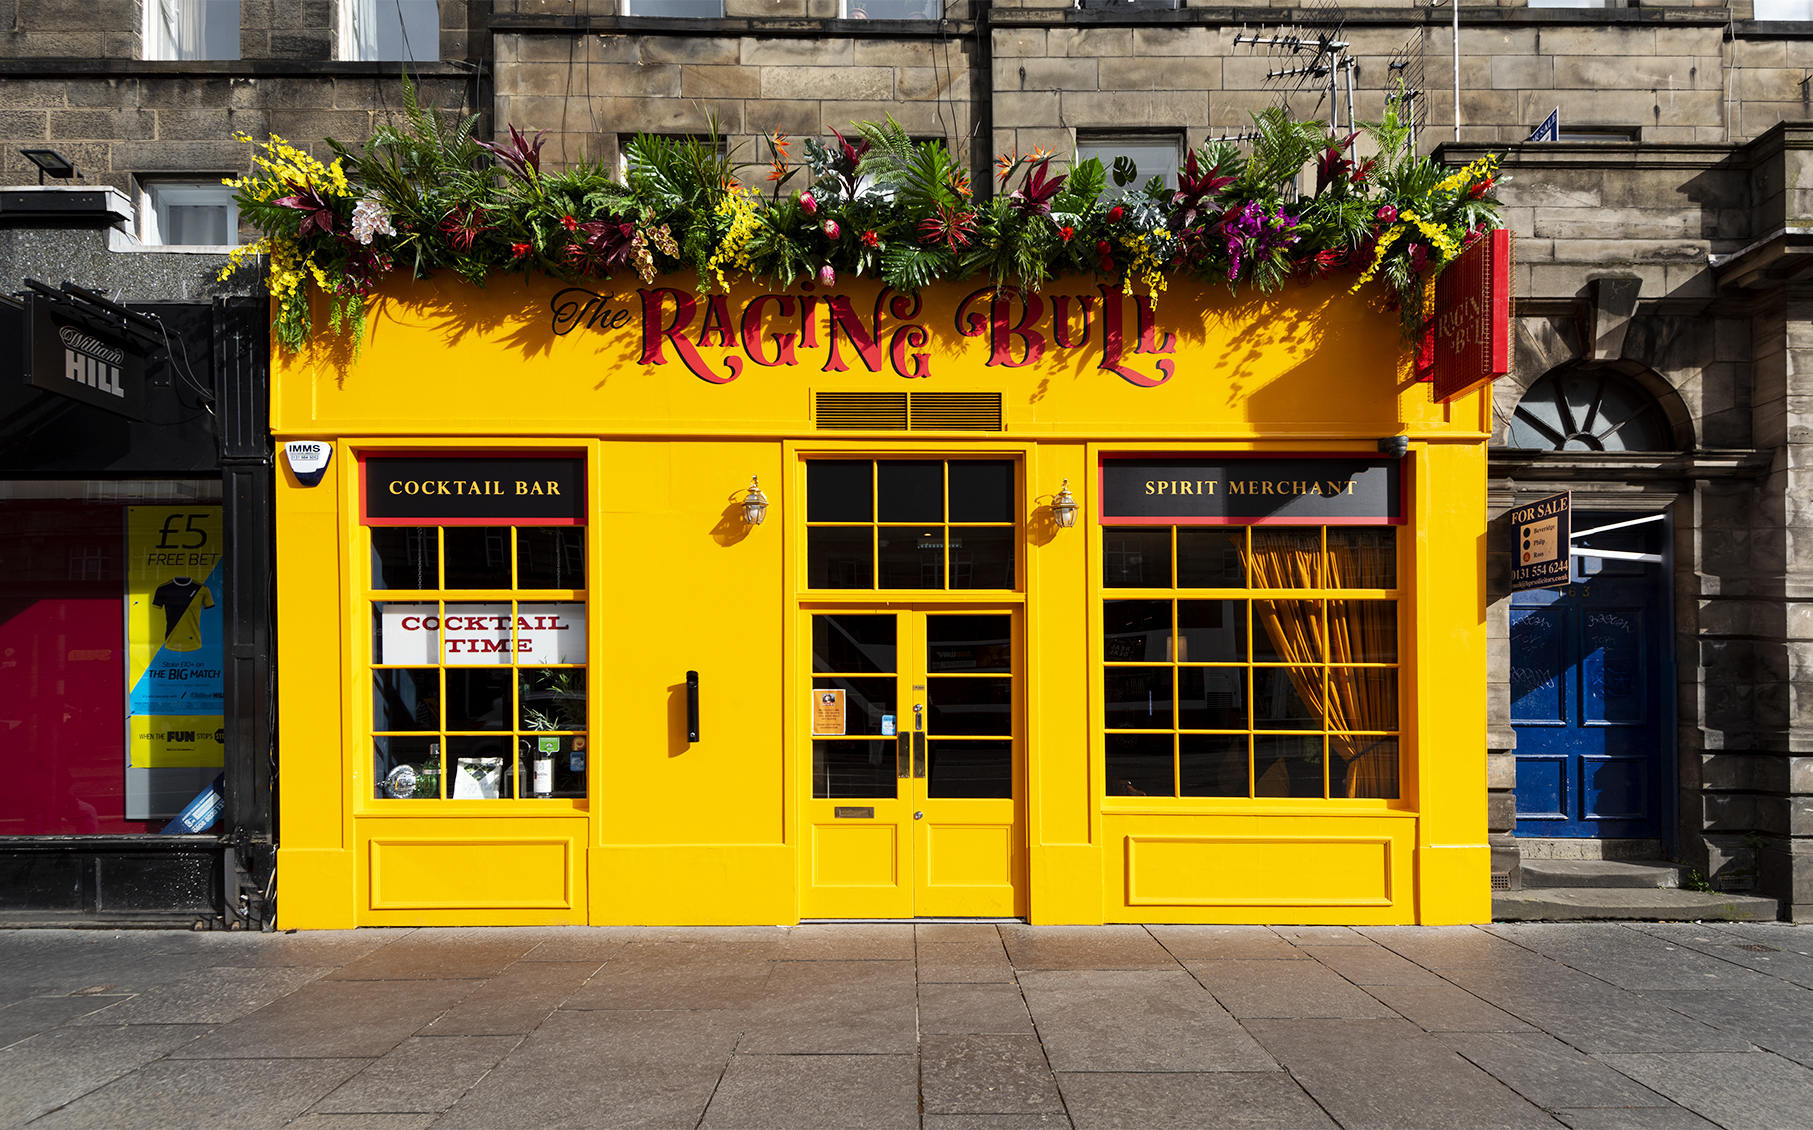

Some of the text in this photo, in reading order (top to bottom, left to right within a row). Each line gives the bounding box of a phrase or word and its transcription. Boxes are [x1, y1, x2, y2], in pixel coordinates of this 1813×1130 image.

[551, 281, 1177, 388] The RAGING BULL
[59, 326, 124, 368] William
[65, 349, 124, 398] HILL
[289, 445, 321, 453] IMMS
[389, 480, 561, 496] COCKTAIL BAR
[1145, 480, 1358, 496] SPIRIT MERCHANT
[1511, 496, 1569, 525] FOR SALE
[155, 514, 210, 549] £5
[148, 553, 219, 566] FREE BET
[1511, 559, 1569, 580] 0131 554 6244
[1558, 586, 1590, 598] 163
[401, 616, 570, 631] COCKTAIL
[444, 638, 533, 653] TIME
[149, 668, 221, 680] THE BIG MATCH
[167, 731, 195, 742] FUN
